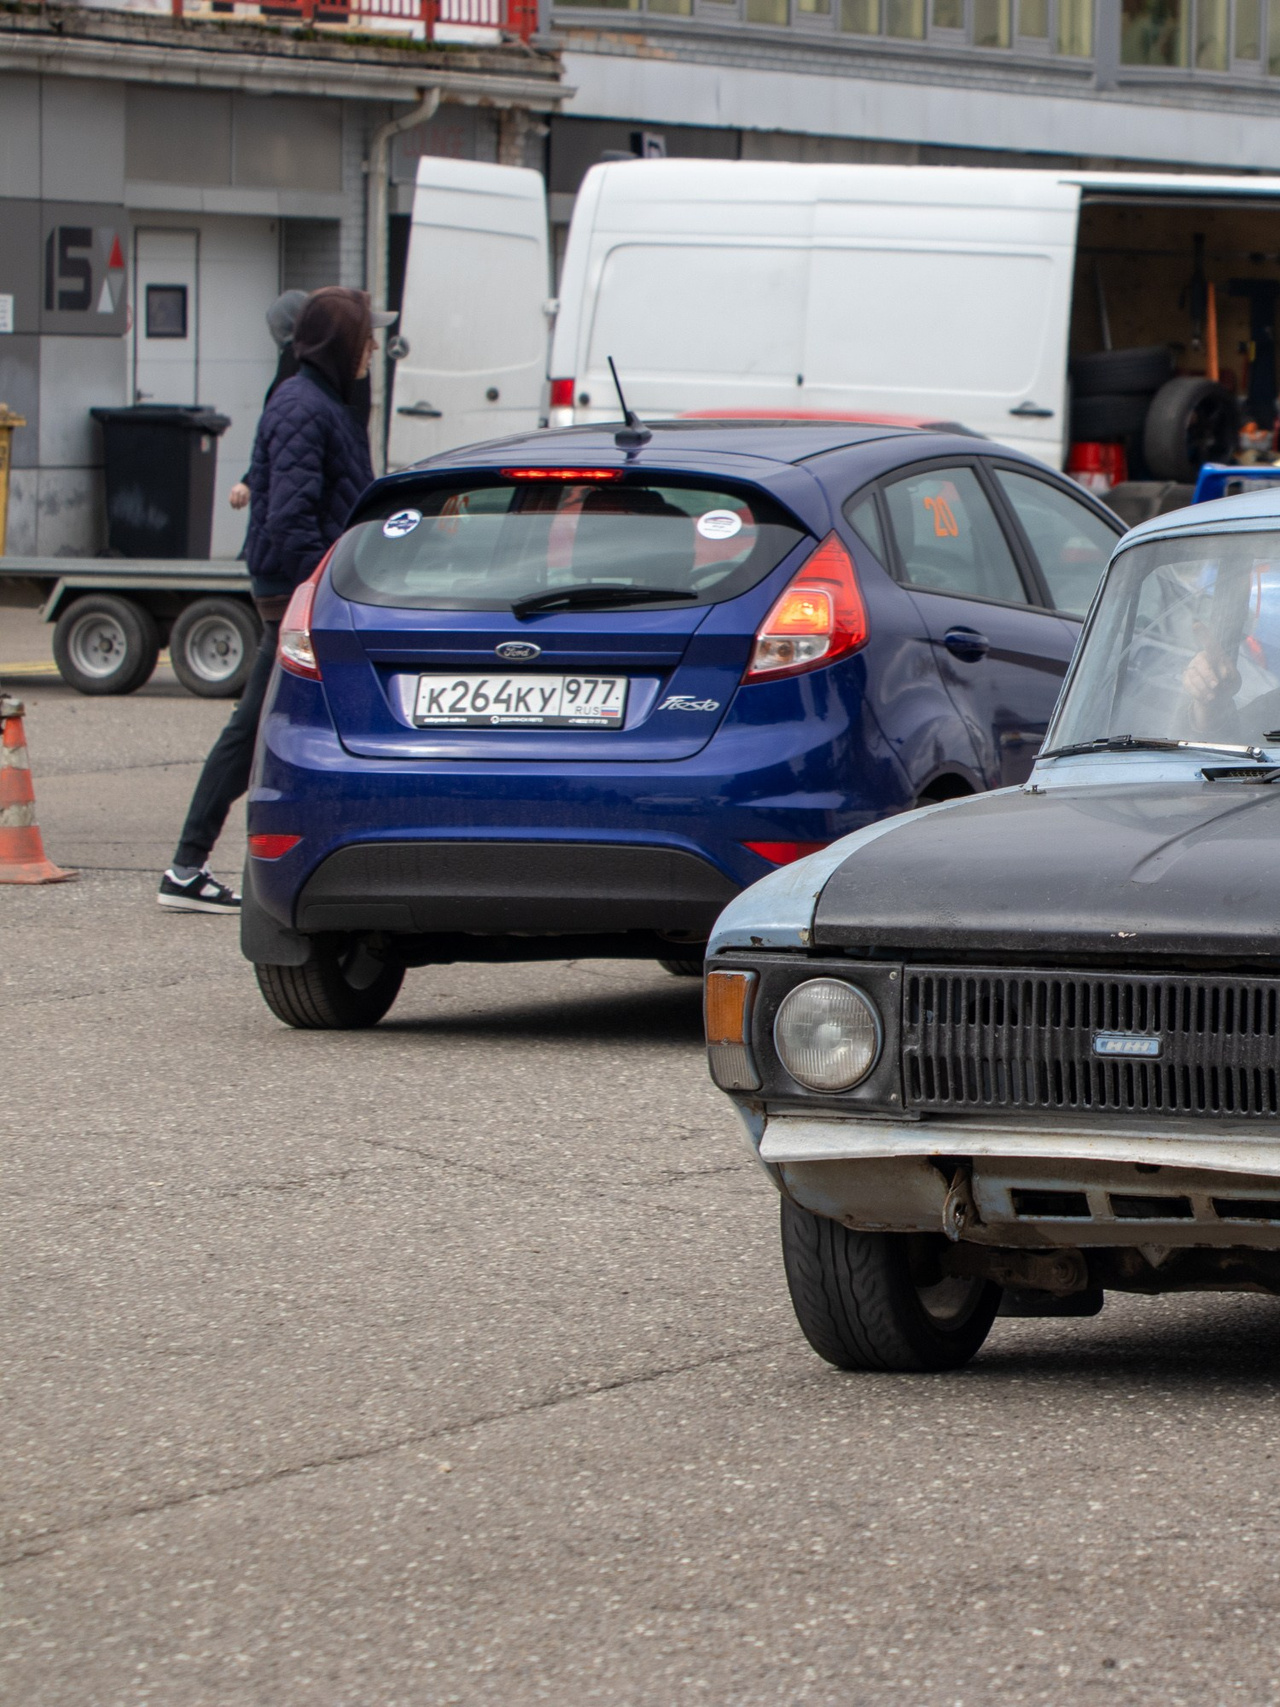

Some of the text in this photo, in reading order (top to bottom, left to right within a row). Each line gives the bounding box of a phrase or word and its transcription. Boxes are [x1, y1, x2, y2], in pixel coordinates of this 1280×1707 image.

[45, 226, 92, 312] 15
[922, 496, 959, 538] 20
[503, 645, 531, 658] Ford
[427, 679, 617, 714] К264КУ 977
[657, 695, 721, 712] Fiesta
[574, 705, 600, 716] RUS
